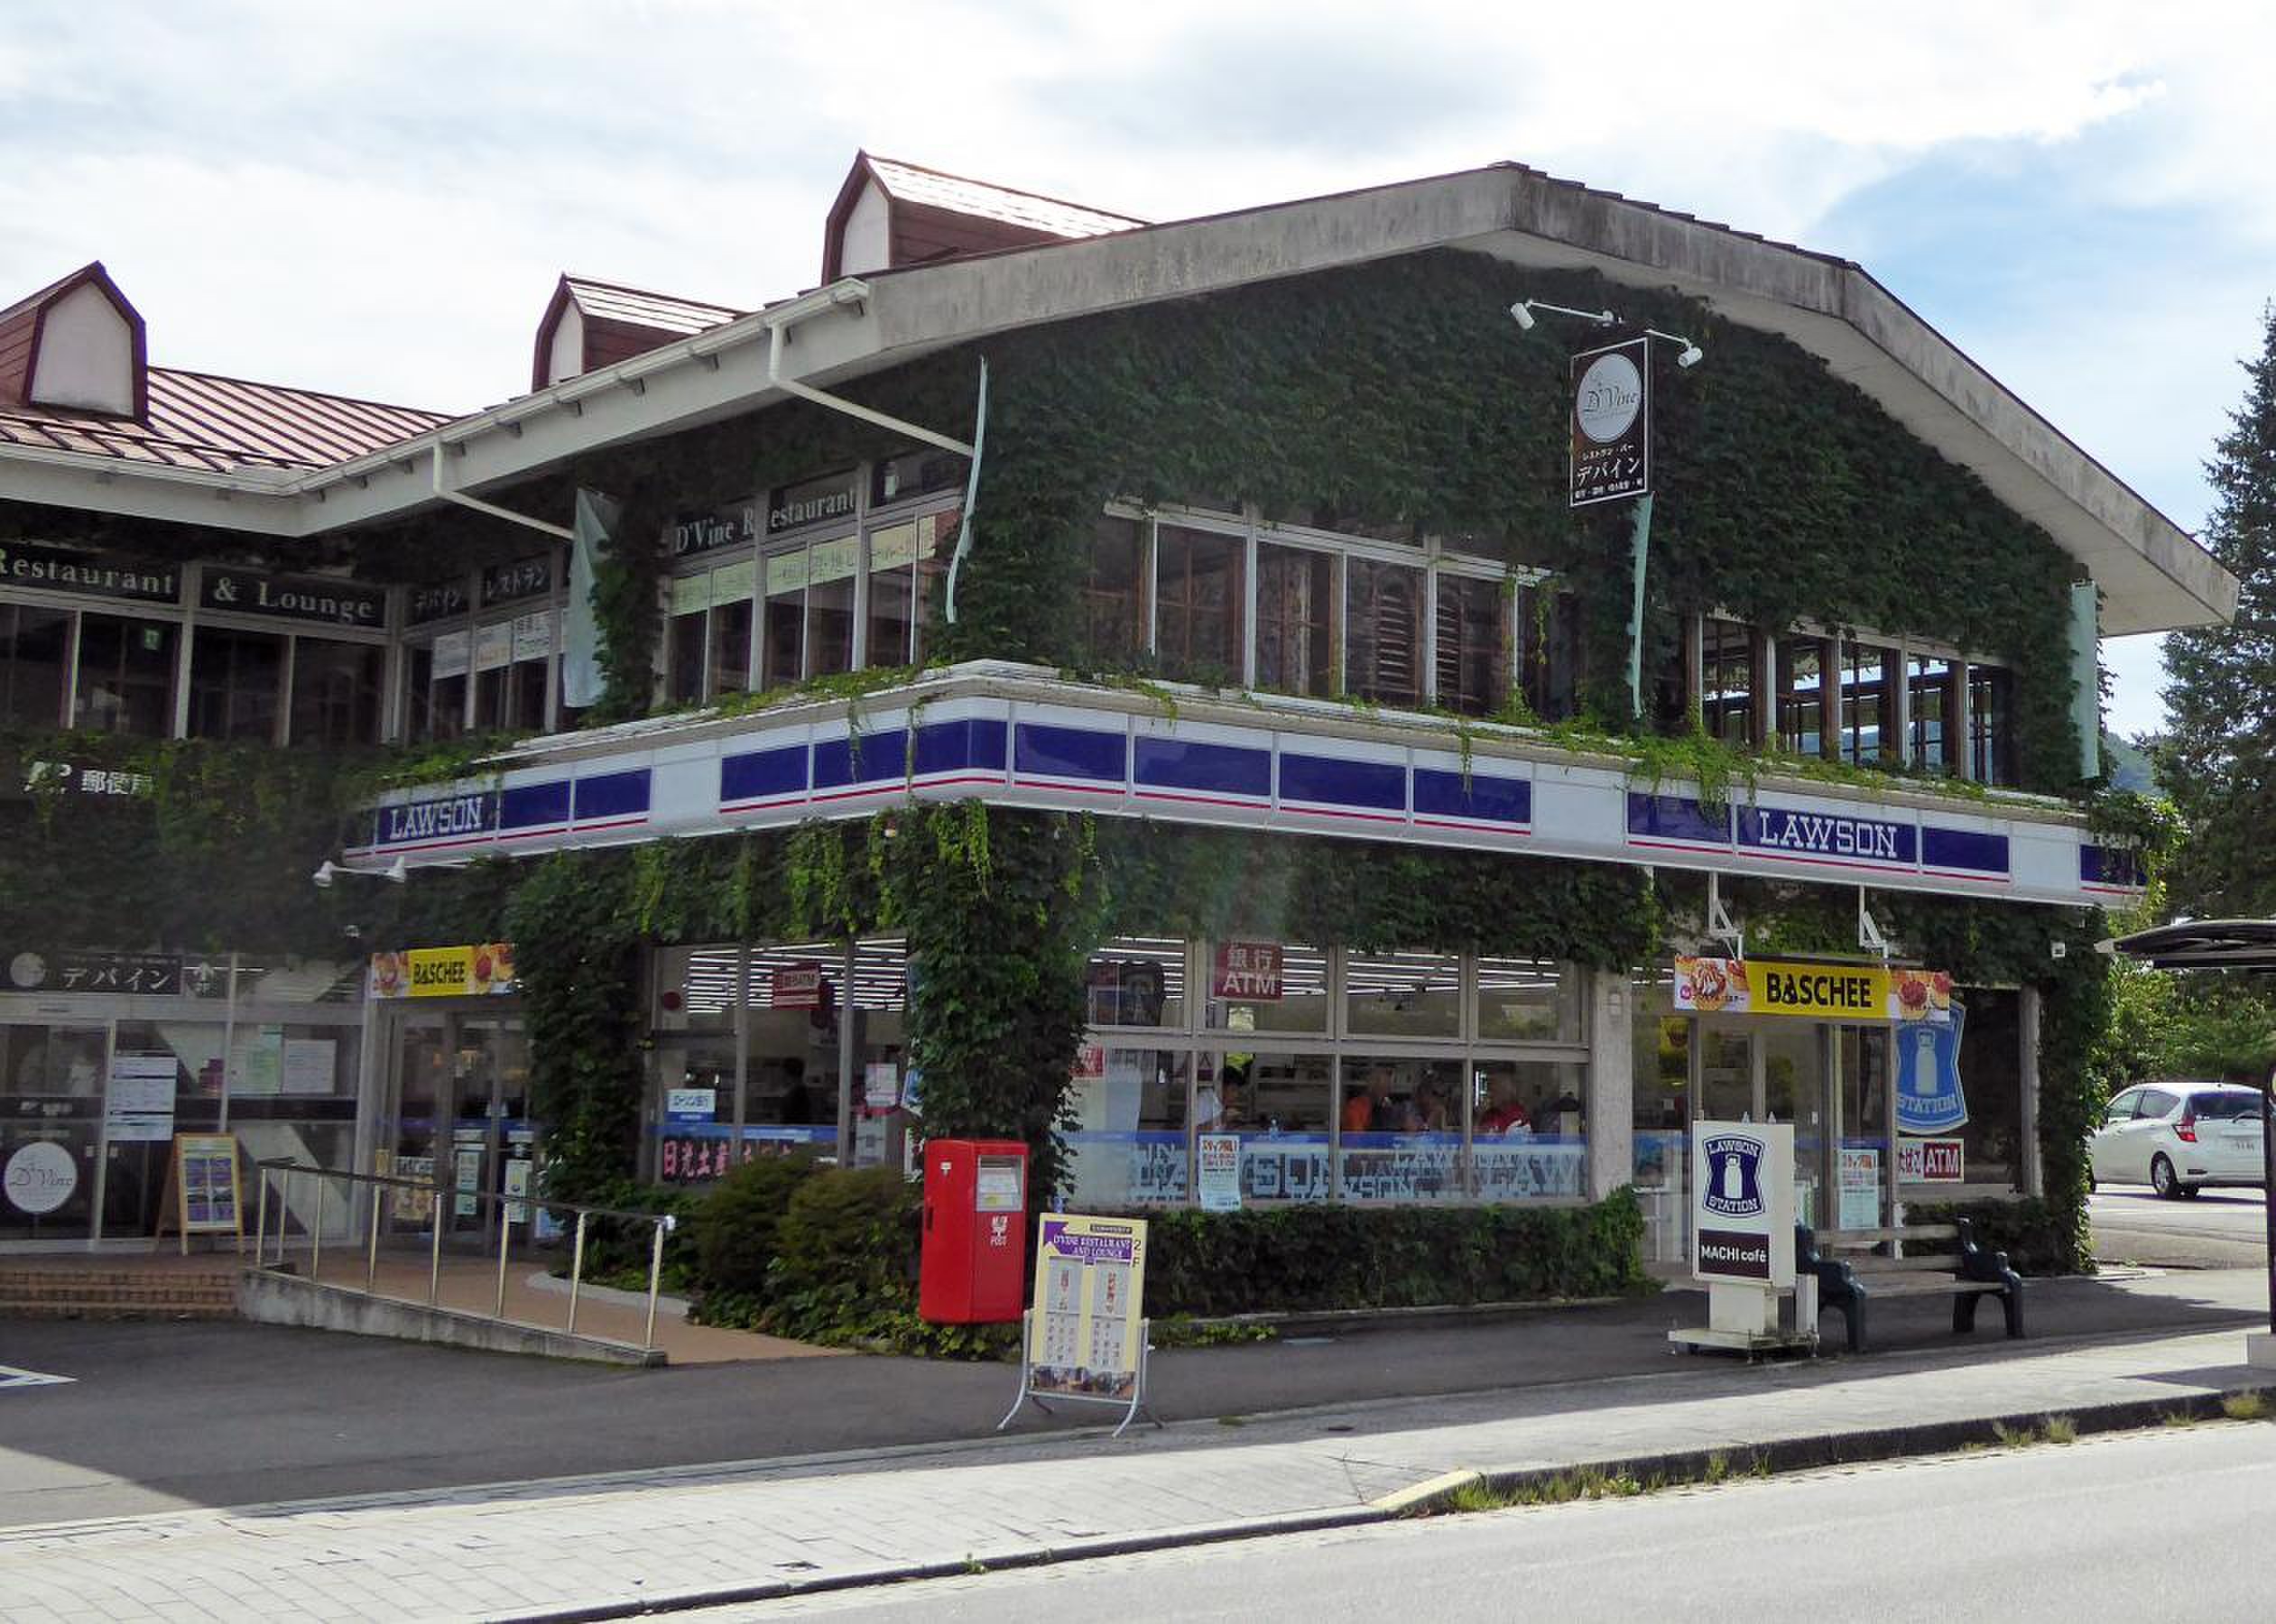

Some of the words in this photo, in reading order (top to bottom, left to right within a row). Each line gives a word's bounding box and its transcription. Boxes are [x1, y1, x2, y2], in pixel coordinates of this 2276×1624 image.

[677, 517, 735, 553] D'Vine
[213, 577, 236, 602] &
[259, 581, 374, 623] Lounge
[390, 797, 483, 840] LAWSON
[1760, 811, 1898, 858] LAWSON
[1223, 972, 1275, 995] ATM
[1765, 973, 1873, 1009] BASCHEE
[1707, 1139, 1759, 1158] LAWSON
[1925, 1145, 1959, 1173] ATM
[1708, 1195, 1759, 1213] STATION
[1701, 1245, 1739, 1261] MACHI
